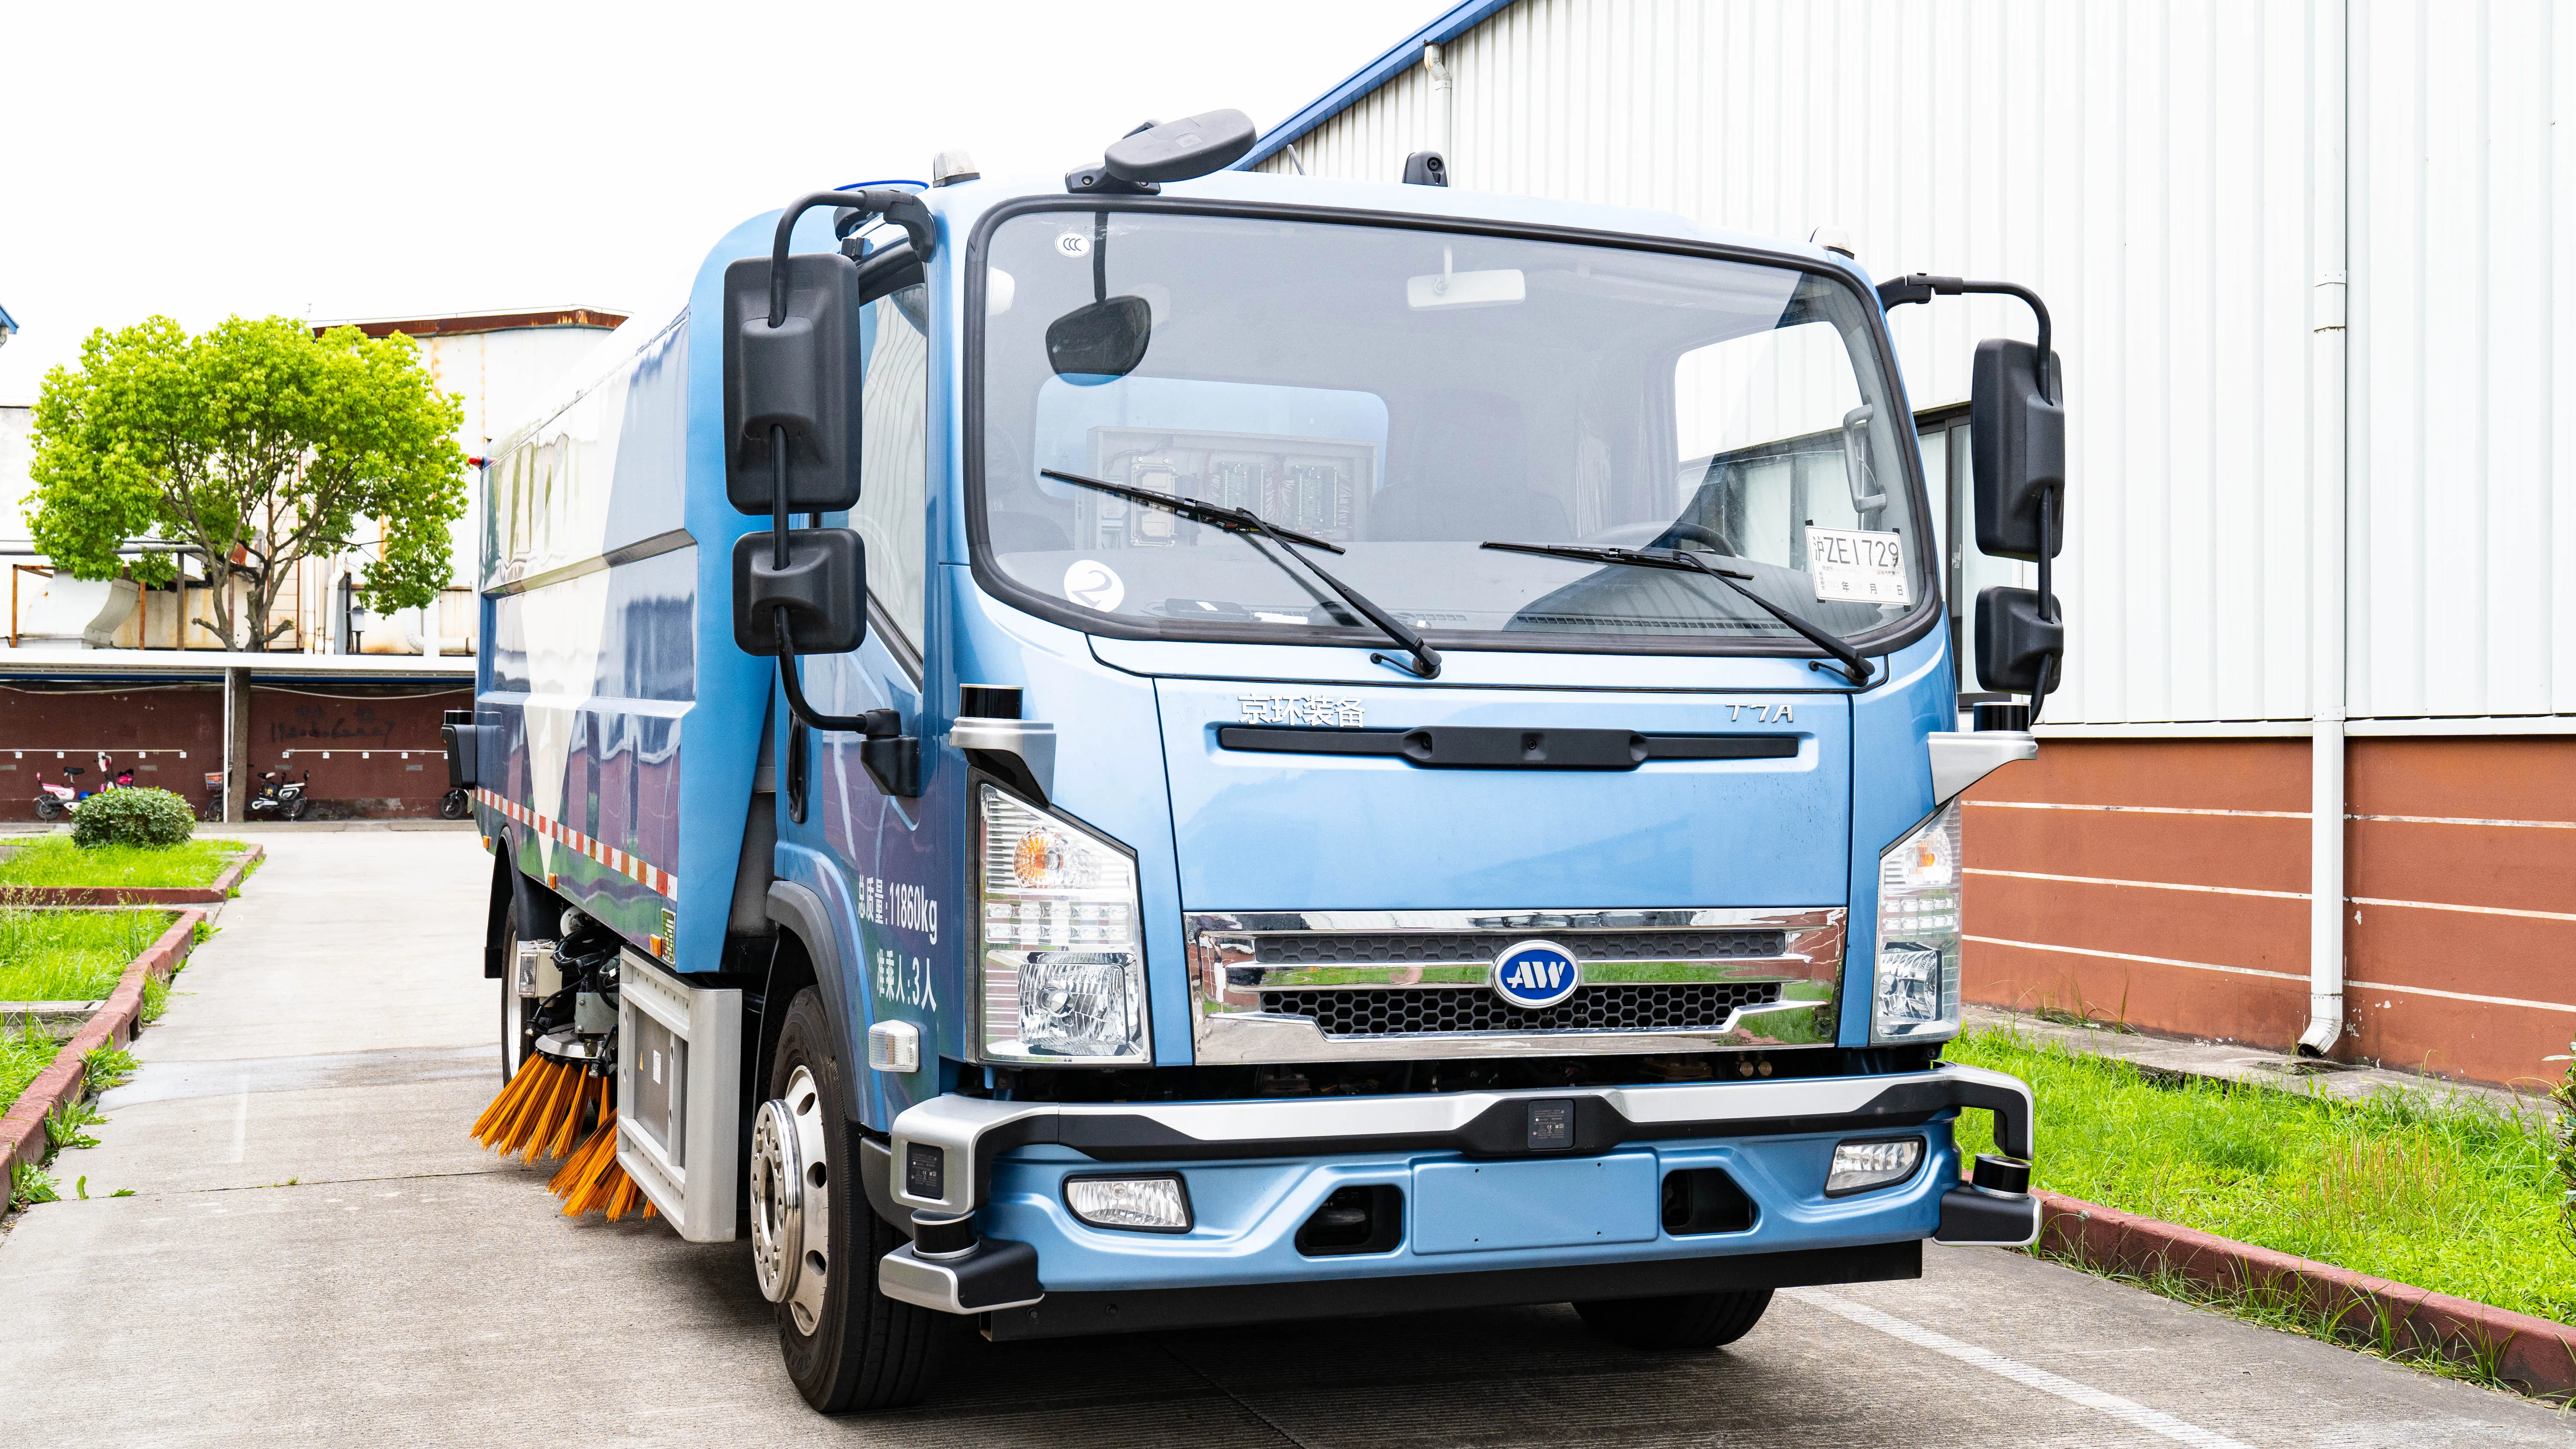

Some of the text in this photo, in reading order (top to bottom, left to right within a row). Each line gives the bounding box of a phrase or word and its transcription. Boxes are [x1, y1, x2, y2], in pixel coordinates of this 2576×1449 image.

[1813, 536, 1899, 567] 沪ZE1729
[1072, 570, 1112, 608] 2
[1870, 583, 1877, 594] 月
[1897, 585, 1903, 596] 日
[1238, 693, 1365, 728] 京环装备
[1725, 703, 1794, 723] T7A
